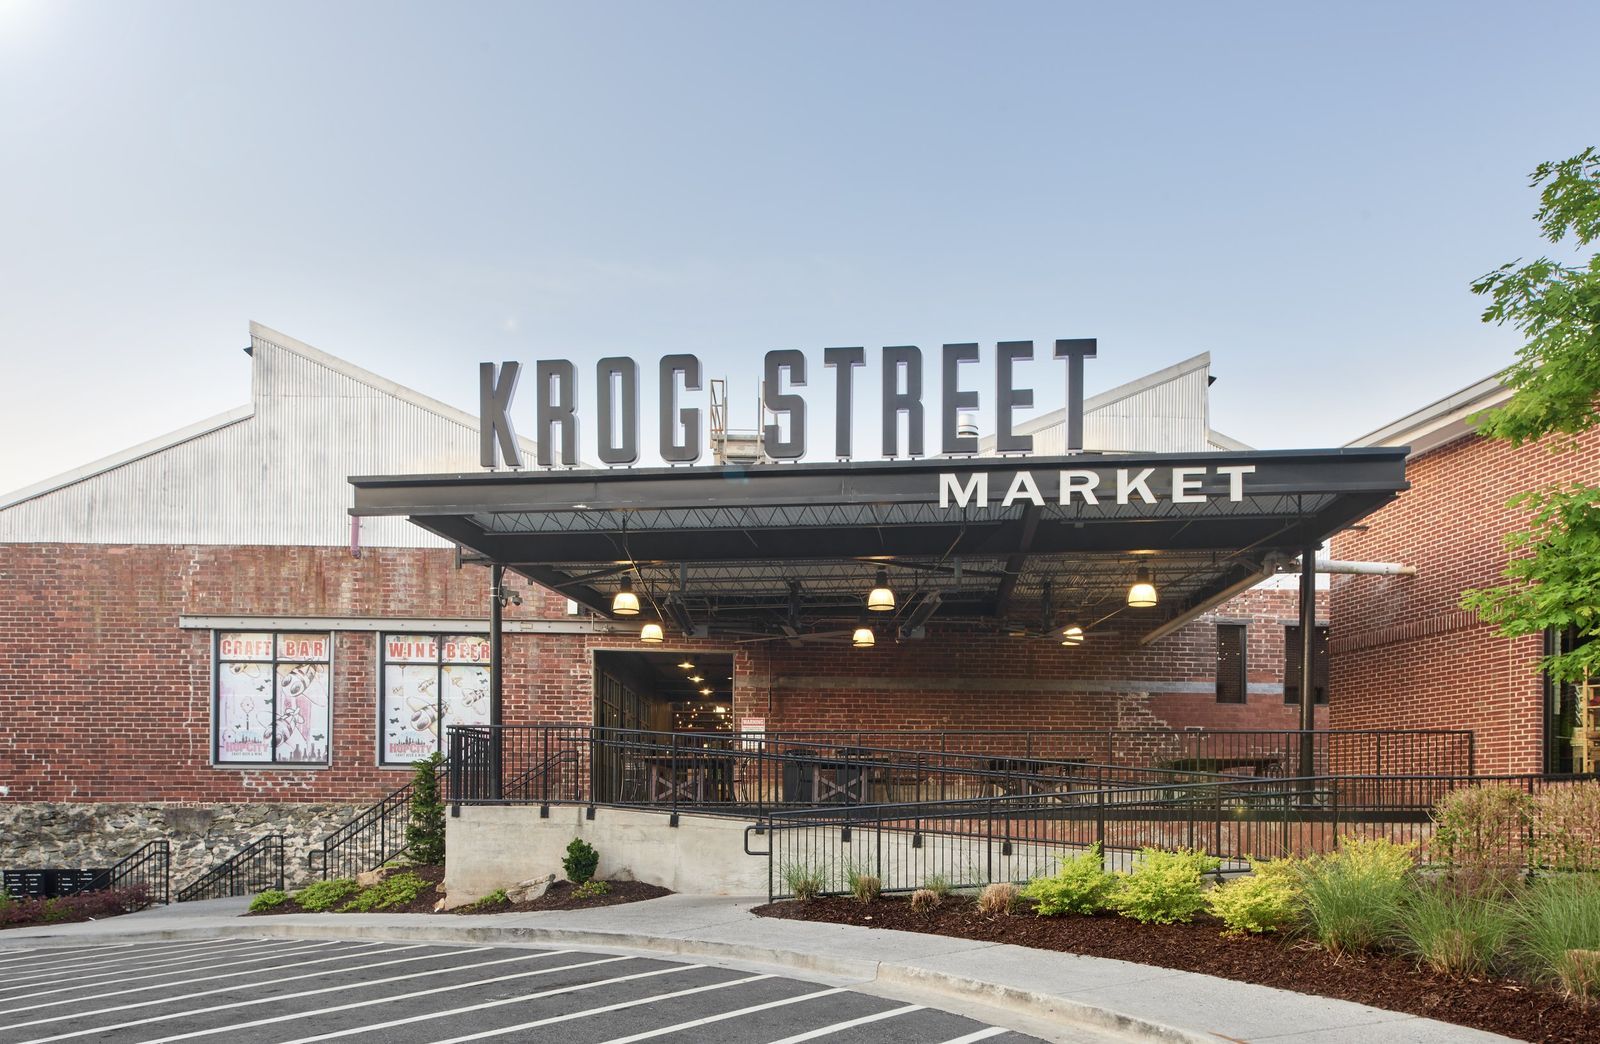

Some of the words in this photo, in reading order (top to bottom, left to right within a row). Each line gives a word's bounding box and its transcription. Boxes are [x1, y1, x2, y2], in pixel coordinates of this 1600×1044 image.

[479, 353, 703, 466] KROG
[764, 338, 1098, 459] STREET
[939, 465, 1256, 508] MARKET
[222, 640, 272, 656] CRAFT
[285, 641, 323, 657] BAR
[389, 642, 437, 658] WINE
[446, 643, 490, 659] BEER
